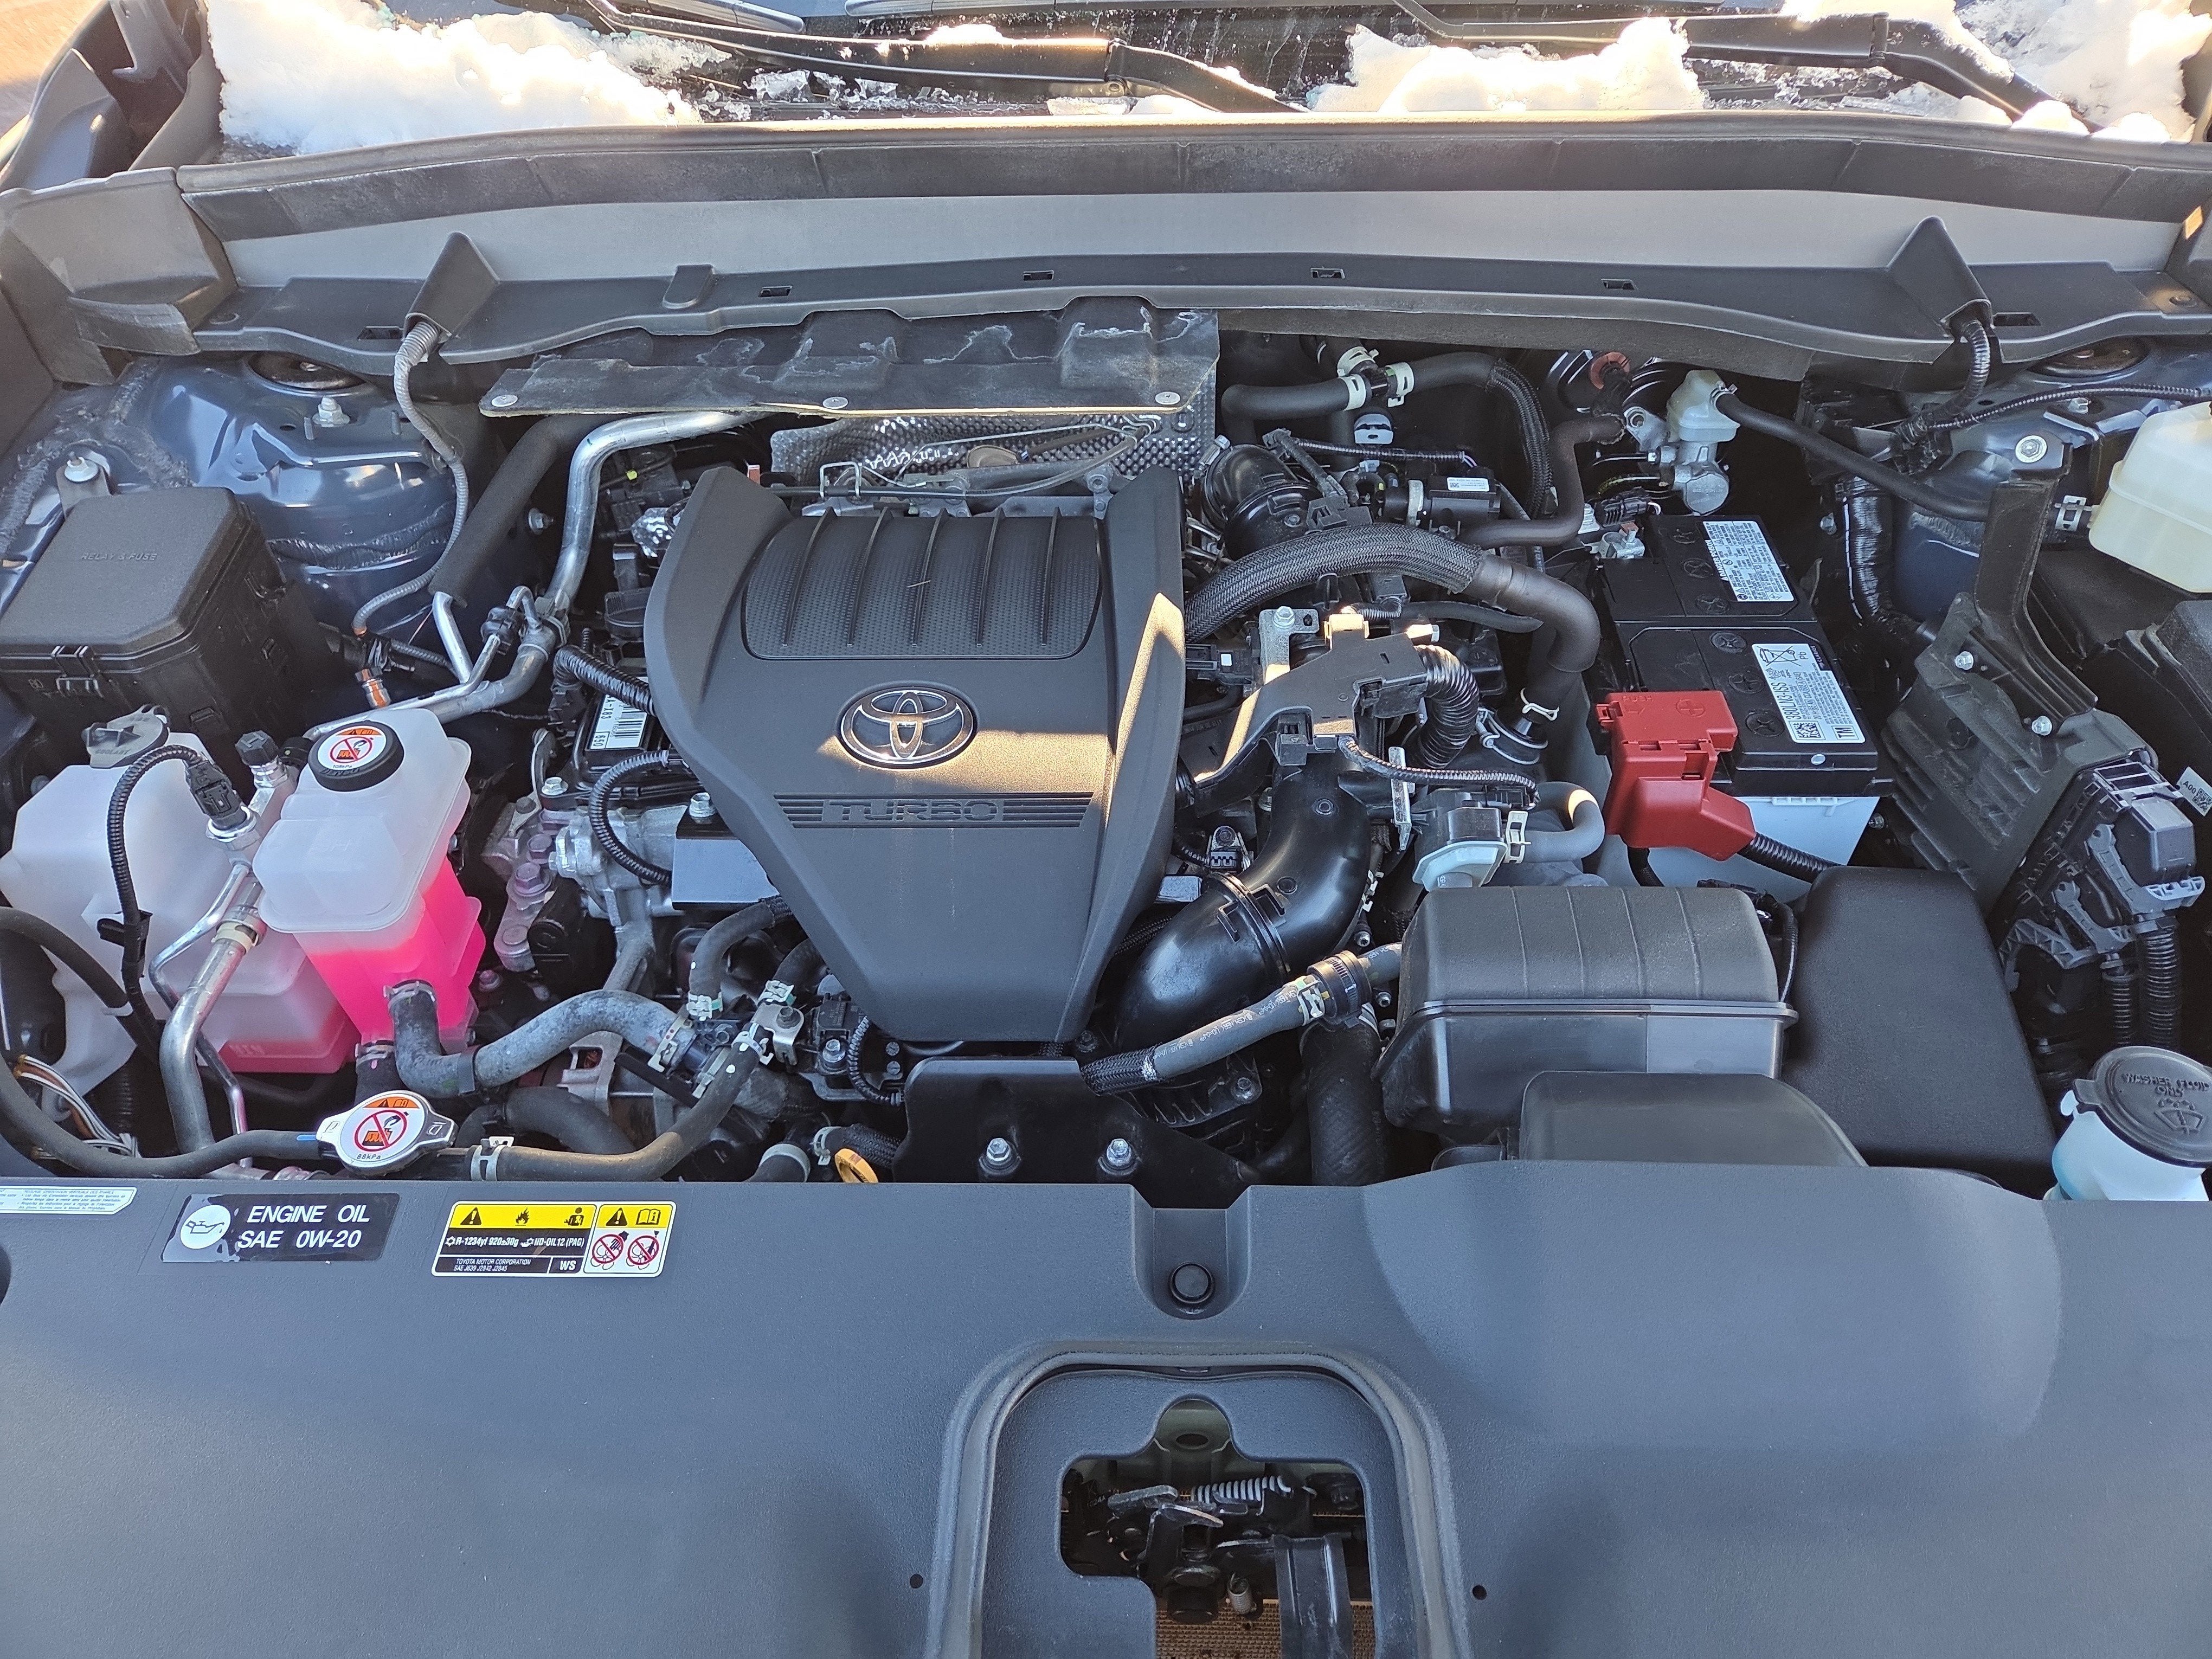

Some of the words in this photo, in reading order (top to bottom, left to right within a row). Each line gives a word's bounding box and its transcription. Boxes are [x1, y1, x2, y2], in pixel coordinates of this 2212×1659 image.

[81, 552, 115, 560] RELAY
[128, 552, 158, 561] FUSE
[1798, 651, 1809, 660] Pb
[1771, 681, 1802, 720] 380LN3-ISS
[1835, 726, 1855, 738] TM
[593, 735, 606, 747] 650
[2182, 781, 2197, 794] A00
[829, 800, 997, 821] TURBO
[2121, 1073, 2171, 1086] WASHER
[2155, 1085, 2184, 1097] ONLY
[247, 1205, 327, 1223] ENGINE
[337, 1205, 370, 1223] OIL
[237, 1230, 284, 1249] SAE
[295, 1230, 362, 1248] 0W-20
[455, 1237, 488, 1247] R-1234yf
[488, 1237, 519, 1248] 920±30g
[565, 1237, 585, 1248] (PAG)
[559, 1260, 577, 1270] WS
